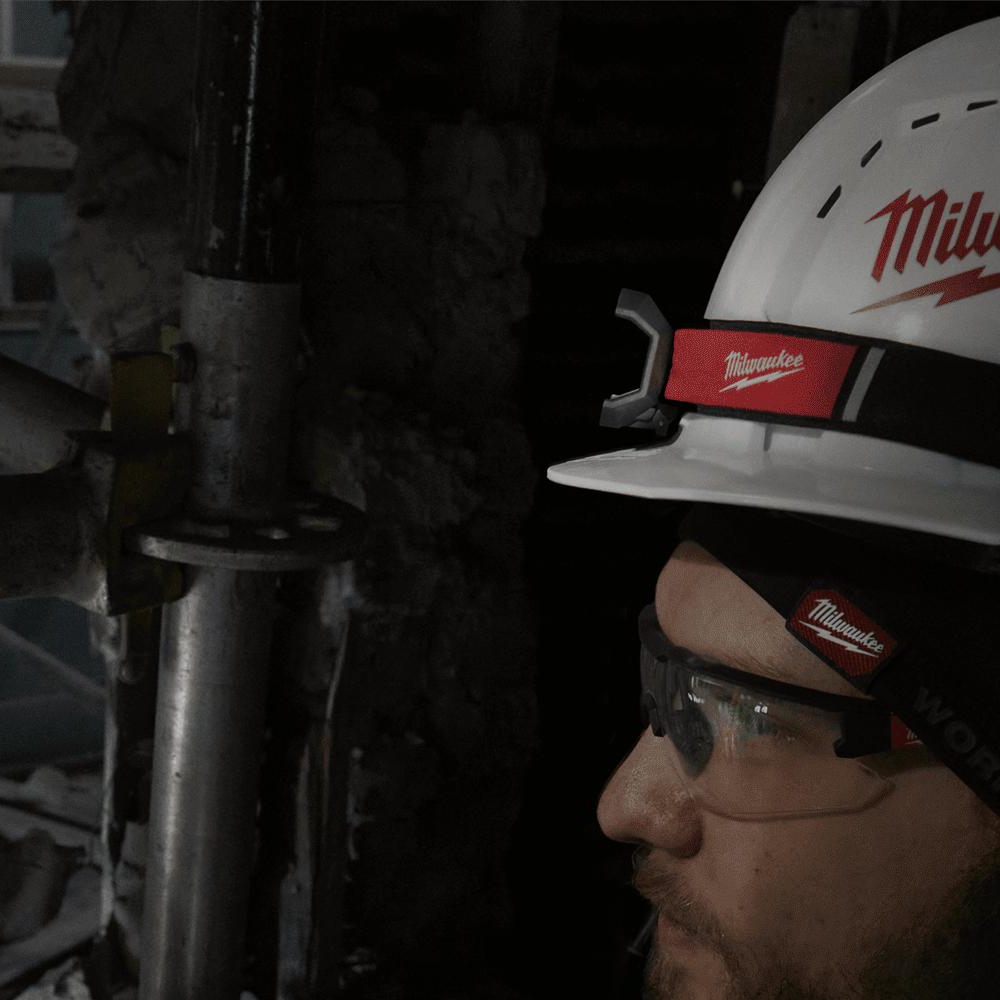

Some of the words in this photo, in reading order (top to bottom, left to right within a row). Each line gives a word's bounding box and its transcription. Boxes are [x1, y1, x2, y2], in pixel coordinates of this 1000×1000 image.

[724, 349, 804, 380] Milwaukee
[808, 599, 884, 653] Milwaukee
[912, 685, 1000, 793] WOR
